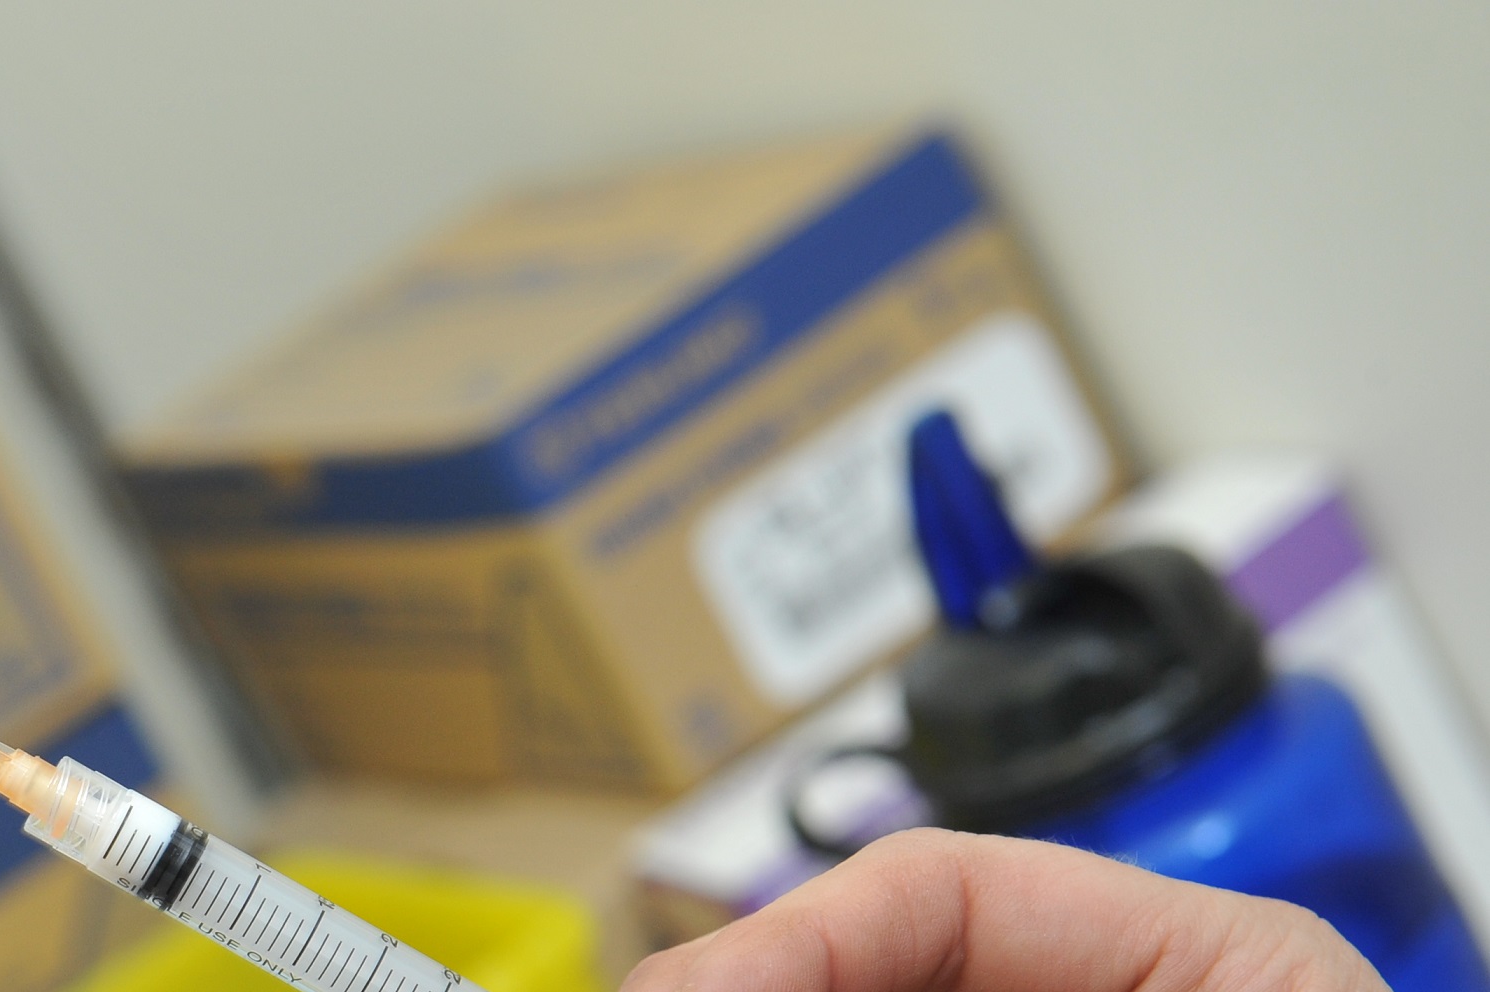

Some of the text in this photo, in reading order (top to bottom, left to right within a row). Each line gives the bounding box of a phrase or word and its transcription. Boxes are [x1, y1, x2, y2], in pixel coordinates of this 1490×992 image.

[115, 876, 302, 986] SINGLE USE ONLY
